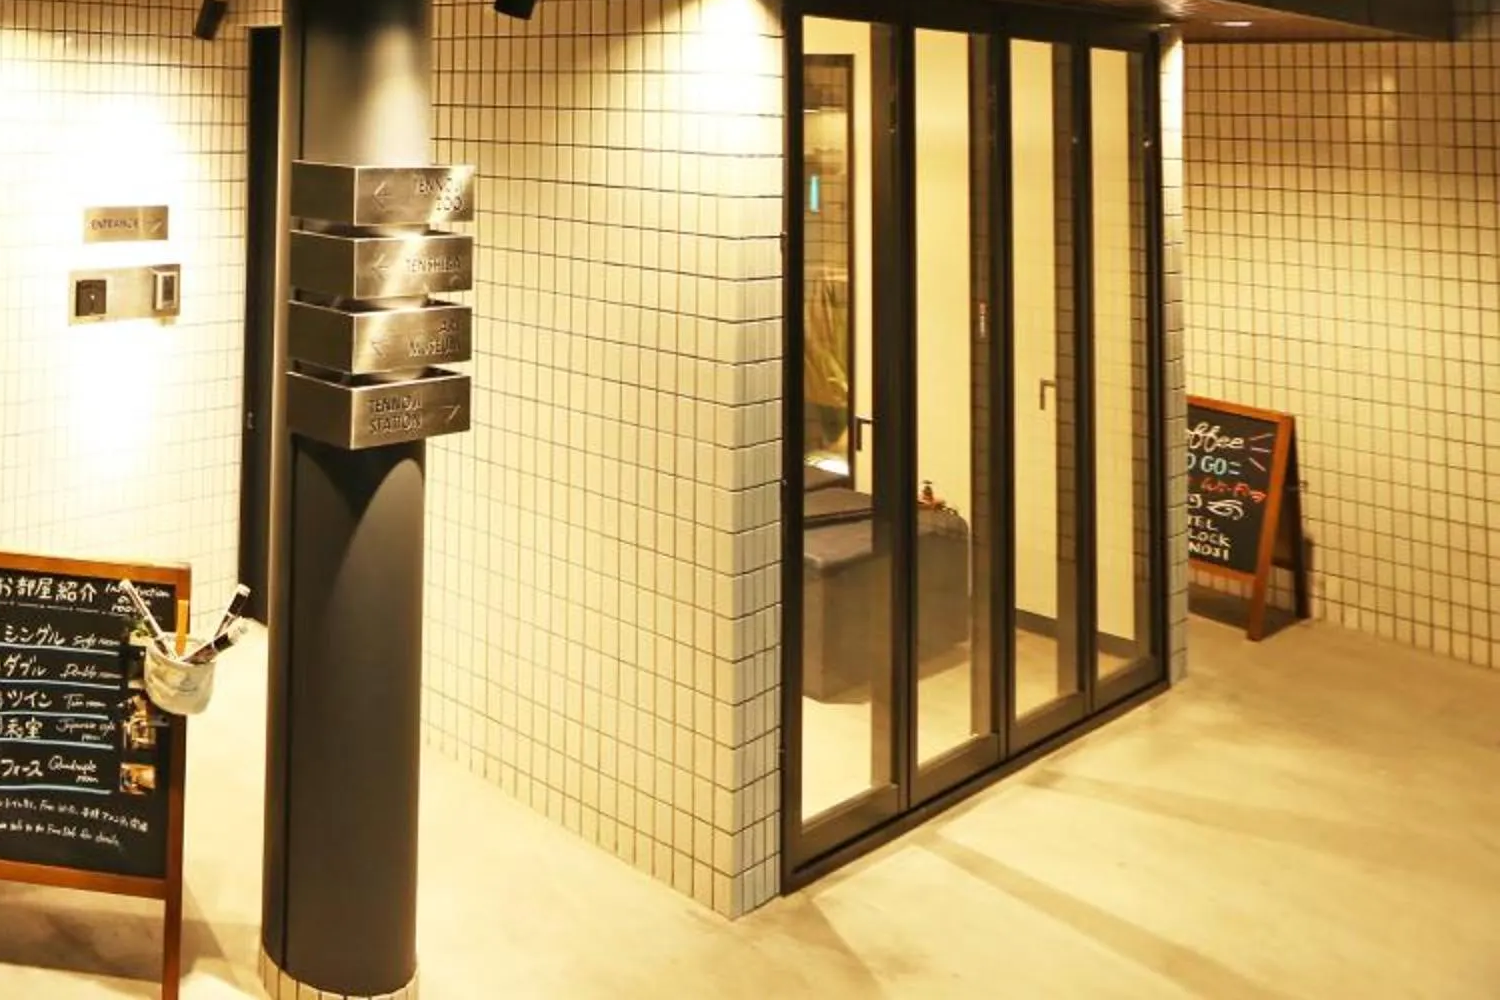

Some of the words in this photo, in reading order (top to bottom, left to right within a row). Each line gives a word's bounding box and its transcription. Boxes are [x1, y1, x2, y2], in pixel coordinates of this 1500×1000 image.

[368, 411, 423, 433] STATION
[3, 652, 48, 678] ダブル
[7, 689, 52, 708] ツイン
[4, 715, 43, 739] 和室
[0, 758, 44, 778] フォース
